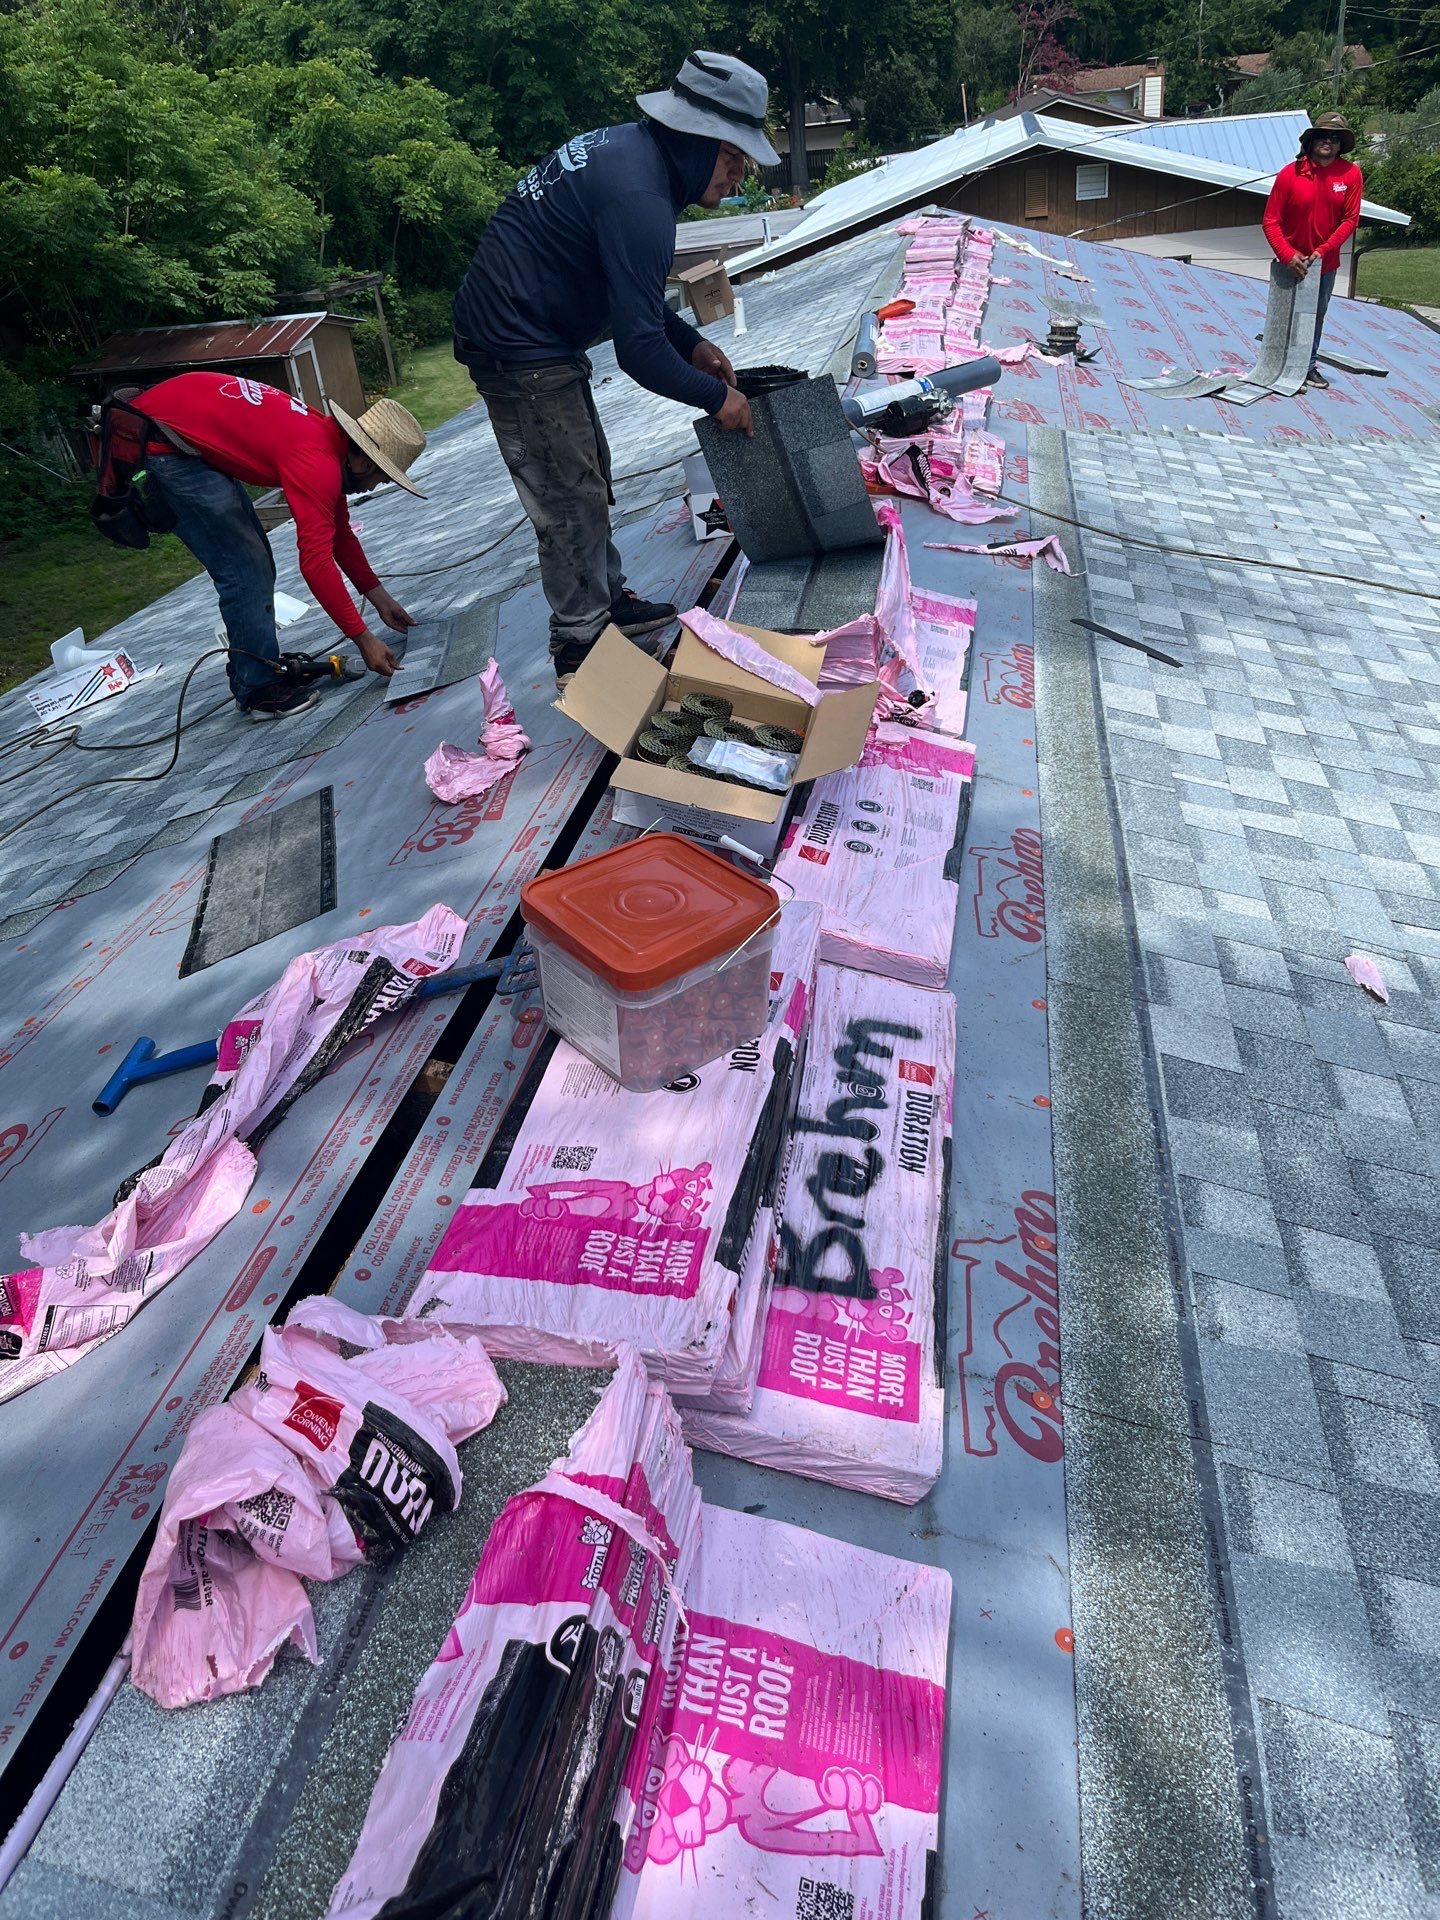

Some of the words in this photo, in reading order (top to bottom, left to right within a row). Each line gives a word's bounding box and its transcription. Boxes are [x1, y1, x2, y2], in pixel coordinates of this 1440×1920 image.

[808, 800, 840, 845] DURATION
[997, 828, 1046, 942] Brehm
[447, 1091, 460, 1107] MAX
[454, 1066, 473, 1094] ROOFING
[467, 1037, 488, 1068] PRODUCTS
[438, 1152, 463, 1189] CERTIFIED
[455, 1142, 467, 1155] TO
[480, 1083, 496, 1104] ASTM
[464, 1143, 482, 1165] ASTM
[898, 1089, 934, 1175] DURATION
[362, 1217, 389, 1256] FOLLOW
[381, 1200, 397, 1219] ALL
[390, 1177, 409, 1202] OSHA
[402, 1132, 433, 1180] GUIDELINES
[370, 1240, 391, 1268] COVER
[383, 1196, 414, 1243] IMMEDIATELY
[406, 1174, 425, 1198] WHEN
[417, 1154, 435, 1177] USING
[428, 1127, 449, 1157] STAPLES
[423, 1243, 434, 1255] FL
[427, 1221, 444, 1244] 42142
[578, 1229, 618, 1276] ROOF
[393, 1234, 426, 1283] INSURANCE
[632, 1237, 669, 1285] THAN
[663, 1240, 696, 1285] MORE
[388, 1281, 401, 1295] OF
[391, 1272, 422, 1319] APPROVAL
[216, 1310, 249, 1357] RESEARCH
[228, 1316, 256, 1355] INTERTEK
[996, 1190, 1065, 1463] Brehm
[194, 1354, 222, 1392] REPORT
[203, 1339, 251, 1412] 855-MAX-FEL
[211, 1352, 233, 1382] CODE
[789, 1330, 822, 1388] ROOF
[822, 1337, 847, 1380] JUST
[846, 1347, 877, 1402] THAN
[878, 1351, 907, 1408] MORE
[820, 1380, 843, 1390] A
[288, 1411, 332, 1446] CORNING
[300, 1406, 338, 1438] OWENS
[360, 1438, 431, 1534] DURA
[590, 1547, 608, 1584] TOTAL
[625, 1546, 650, 1606] PROTECT
[52, 1553, 116, 1652] MAXFELT.COM
[320, 1639, 358, 1696] Owens
[345, 1578, 385, 1640] Corning
[729, 1647, 758, 1664] A
[9, 1650, 58, 1720] MAXFELT
[678, 1633, 726, 1715] THAN
[716, 1665, 753, 1730] JUST
[749, 1651, 794, 1741] ROOF
